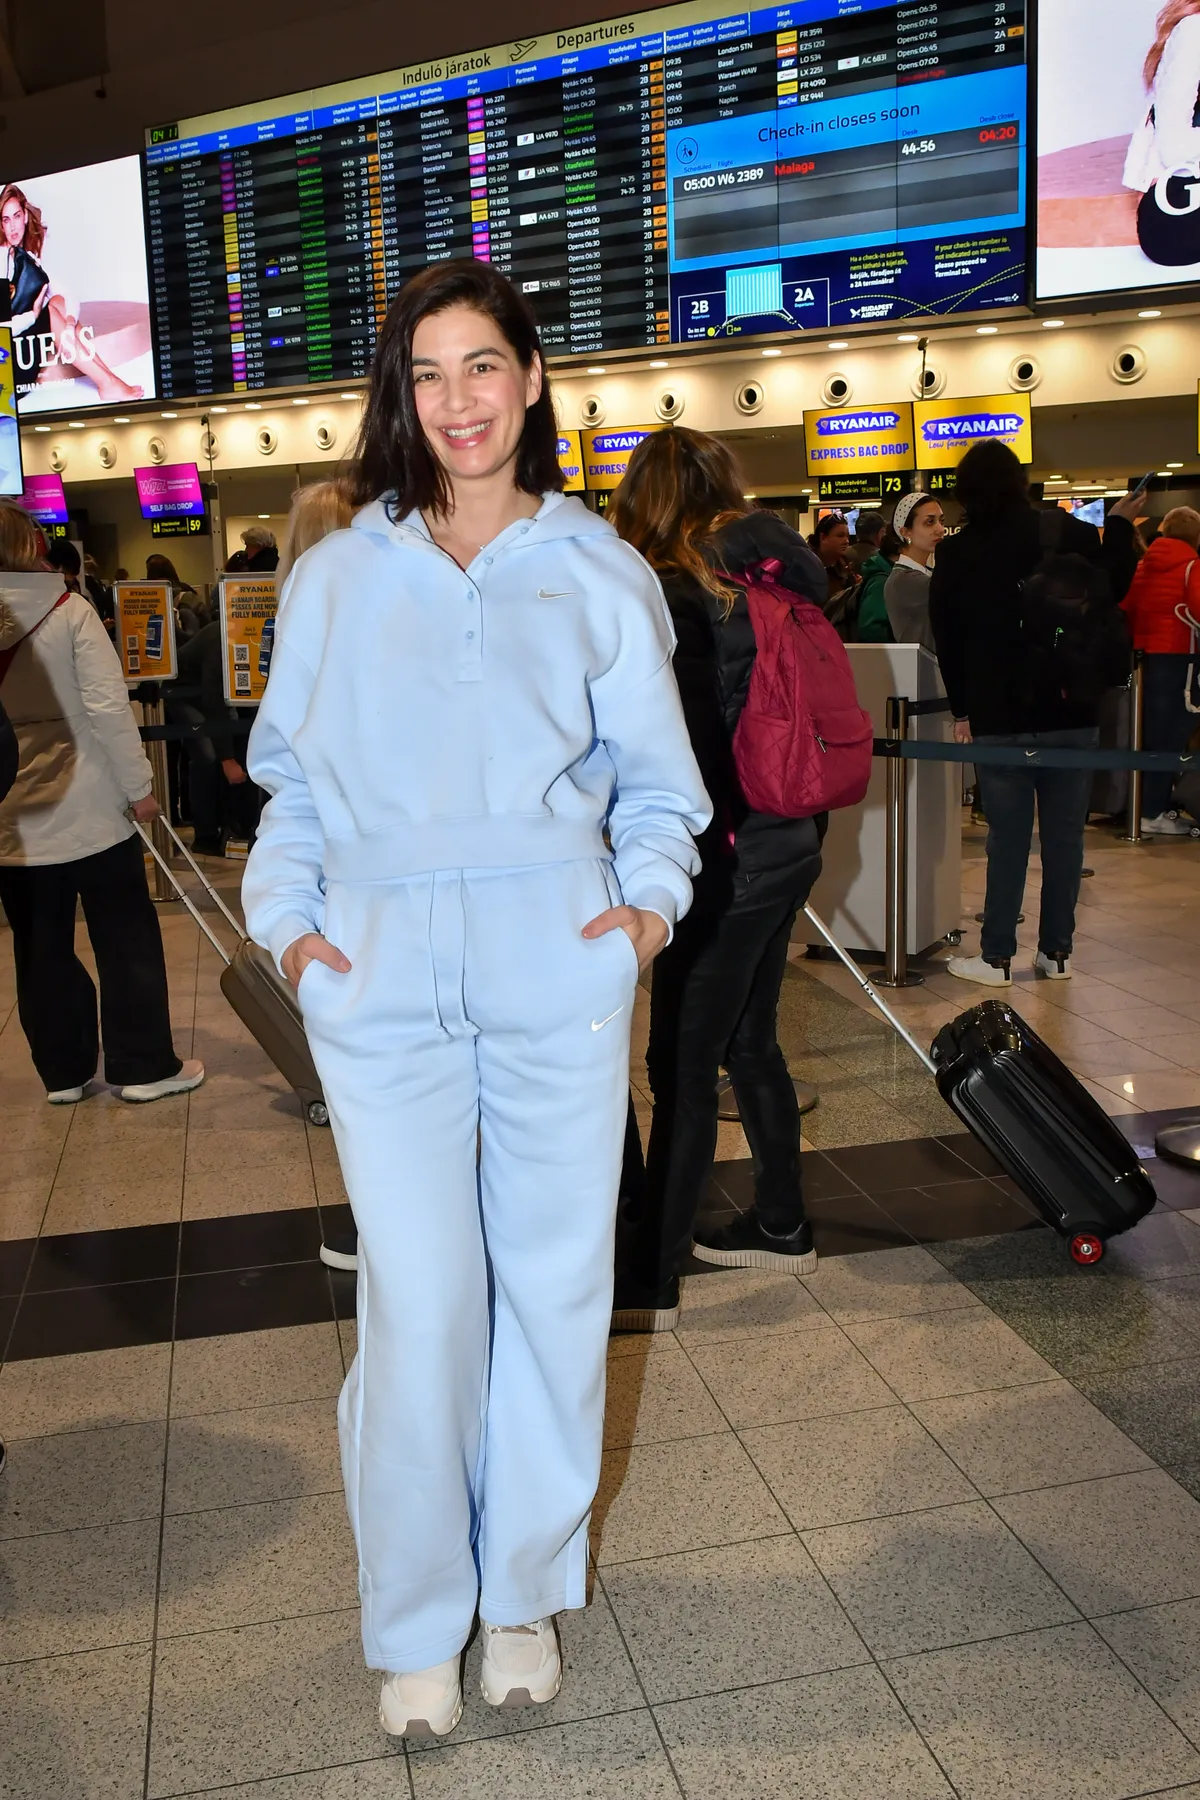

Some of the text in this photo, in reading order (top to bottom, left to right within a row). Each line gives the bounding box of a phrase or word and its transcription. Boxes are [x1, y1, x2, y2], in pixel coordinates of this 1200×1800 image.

[994, 3, 1005, 13] 2B
[994, 16, 1006, 25] 2A
[557, 22, 635, 49] Departures
[800, 30, 808, 38] FR
[994, 30, 1006, 39] 2A
[718, 42, 753, 56] London STN
[994, 43, 1005, 53] 2B
[718, 59, 734, 68] Basel
[861, 56, 872, 64] AC
[403, 53, 491, 85] Induló járatok
[718, 70, 740, 80] Warsaw
[718, 83, 736, 93] Zurich
[800, 81, 809, 89] FR
[719, 95, 739, 105] Naples
[719, 109, 733, 117] Taba
[758, 104, 920, 142] Check-in closes soon
[979, 125, 1016, 143] 04:20
[902, 140, 936, 155] 44-56
[775, 161, 814, 176] Malaga
[684, 168, 763, 191] 05:00 W6 2389
[953, 241, 978, 250] check-in
[935, 269, 960, 278] Terminal
[794, 286, 815, 303] 2A
[691, 300, 709, 315] 2B
[860, 309, 888, 319] AIRPORT
[13, 326, 95, 371] UESS
[829, 415, 895, 431] RYANAIR
[938, 417, 1018, 435] RYANAIR
[811, 443, 909, 460] EXPRESS BAG DROP
[562, 466, 579, 477] ROP
[885, 477, 902, 492] 73
[835, 487, 859, 495] Check-in
[190, 519, 201, 531] 59
[56, 526, 65, 536] 58
[251, 610, 275, 618] MOBILE
